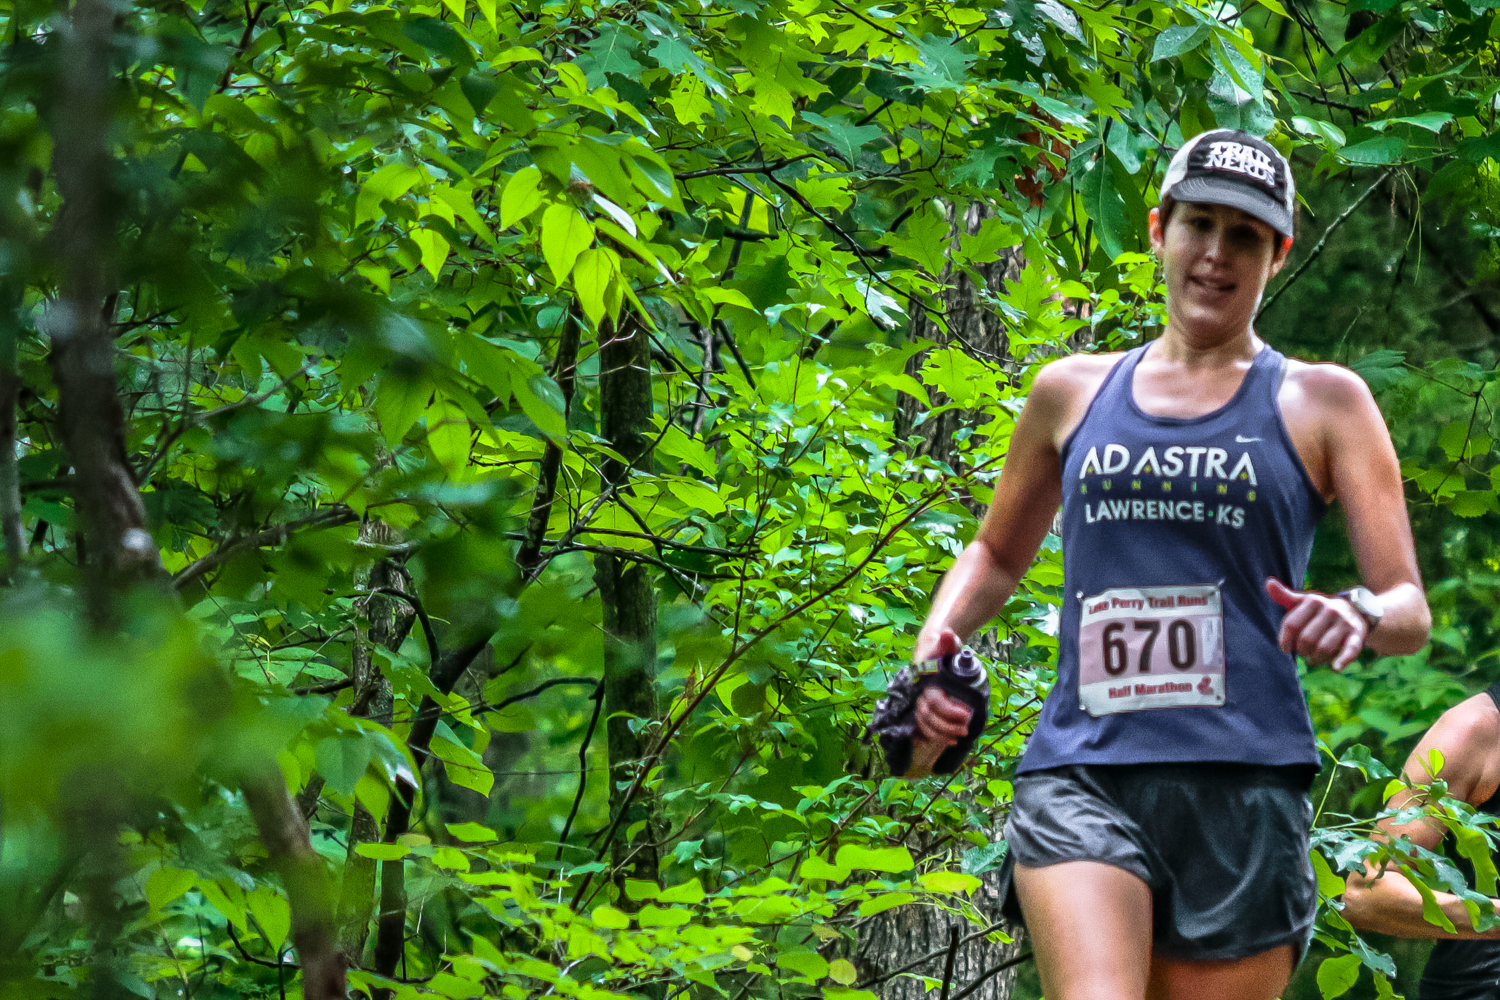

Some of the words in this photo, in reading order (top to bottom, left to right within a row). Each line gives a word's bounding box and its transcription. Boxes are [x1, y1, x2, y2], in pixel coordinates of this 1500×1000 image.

[1203, 154, 1275, 187] NERDS
[1209, 141, 1275, 174] TRAIL
[1079, 444, 1131, 479] AD
[1132, 446, 1258, 487] ASTRA
[1111, 597, 1145, 611] Perry
[1147, 595, 1175, 608] Trail
[1177, 594, 1209, 607] Runs
[1102, 618, 1197, 676] 670
[1109, 685, 1131, 699] Half
[1134, 682, 1193, 696] Marathon
